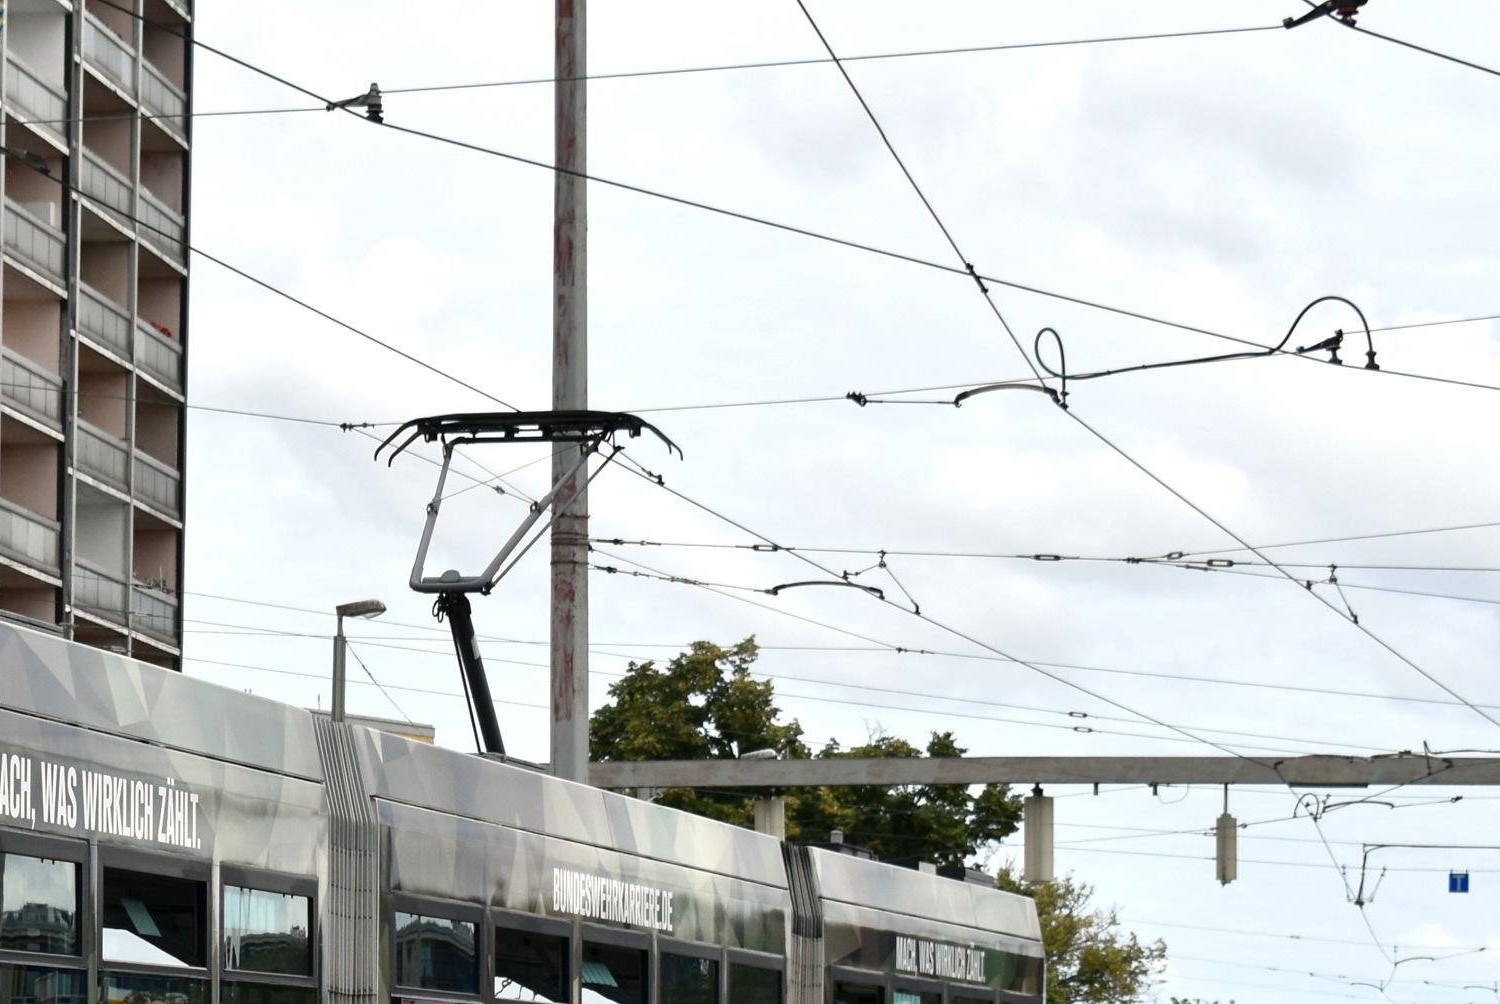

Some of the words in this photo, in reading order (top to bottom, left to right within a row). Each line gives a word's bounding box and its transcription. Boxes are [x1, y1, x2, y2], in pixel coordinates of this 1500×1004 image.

[40, 762, 77, 830] WAS
[82, 771, 154, 841] WIRKLICH
[157, 777, 201, 849] ZÄHLT.
[553, 867, 673, 931] BUNDESWEHRKARRIERE.DE
